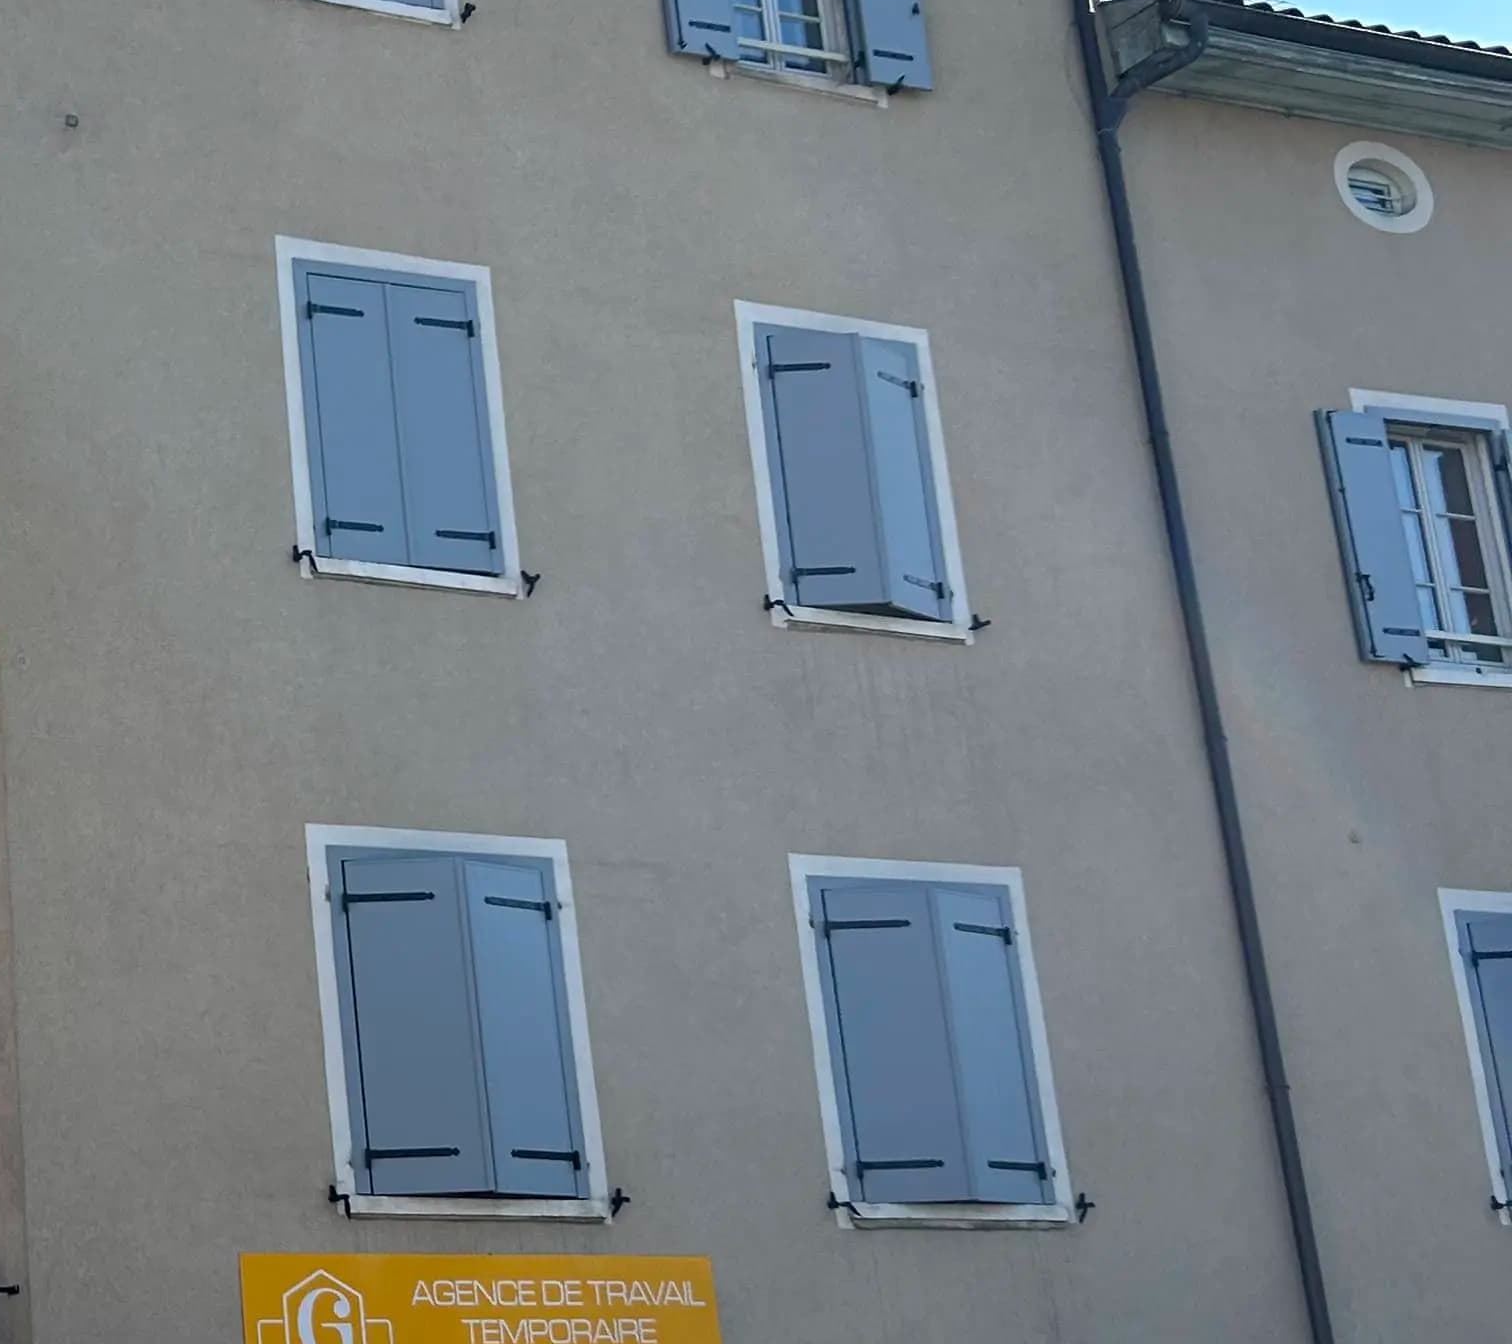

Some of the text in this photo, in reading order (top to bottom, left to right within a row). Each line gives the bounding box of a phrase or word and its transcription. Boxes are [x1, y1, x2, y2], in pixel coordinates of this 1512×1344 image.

[411, 1280, 707, 1306] AGENCE DE TRAVAIL
[460, 1318, 659, 1344] TEMPORAIRE
